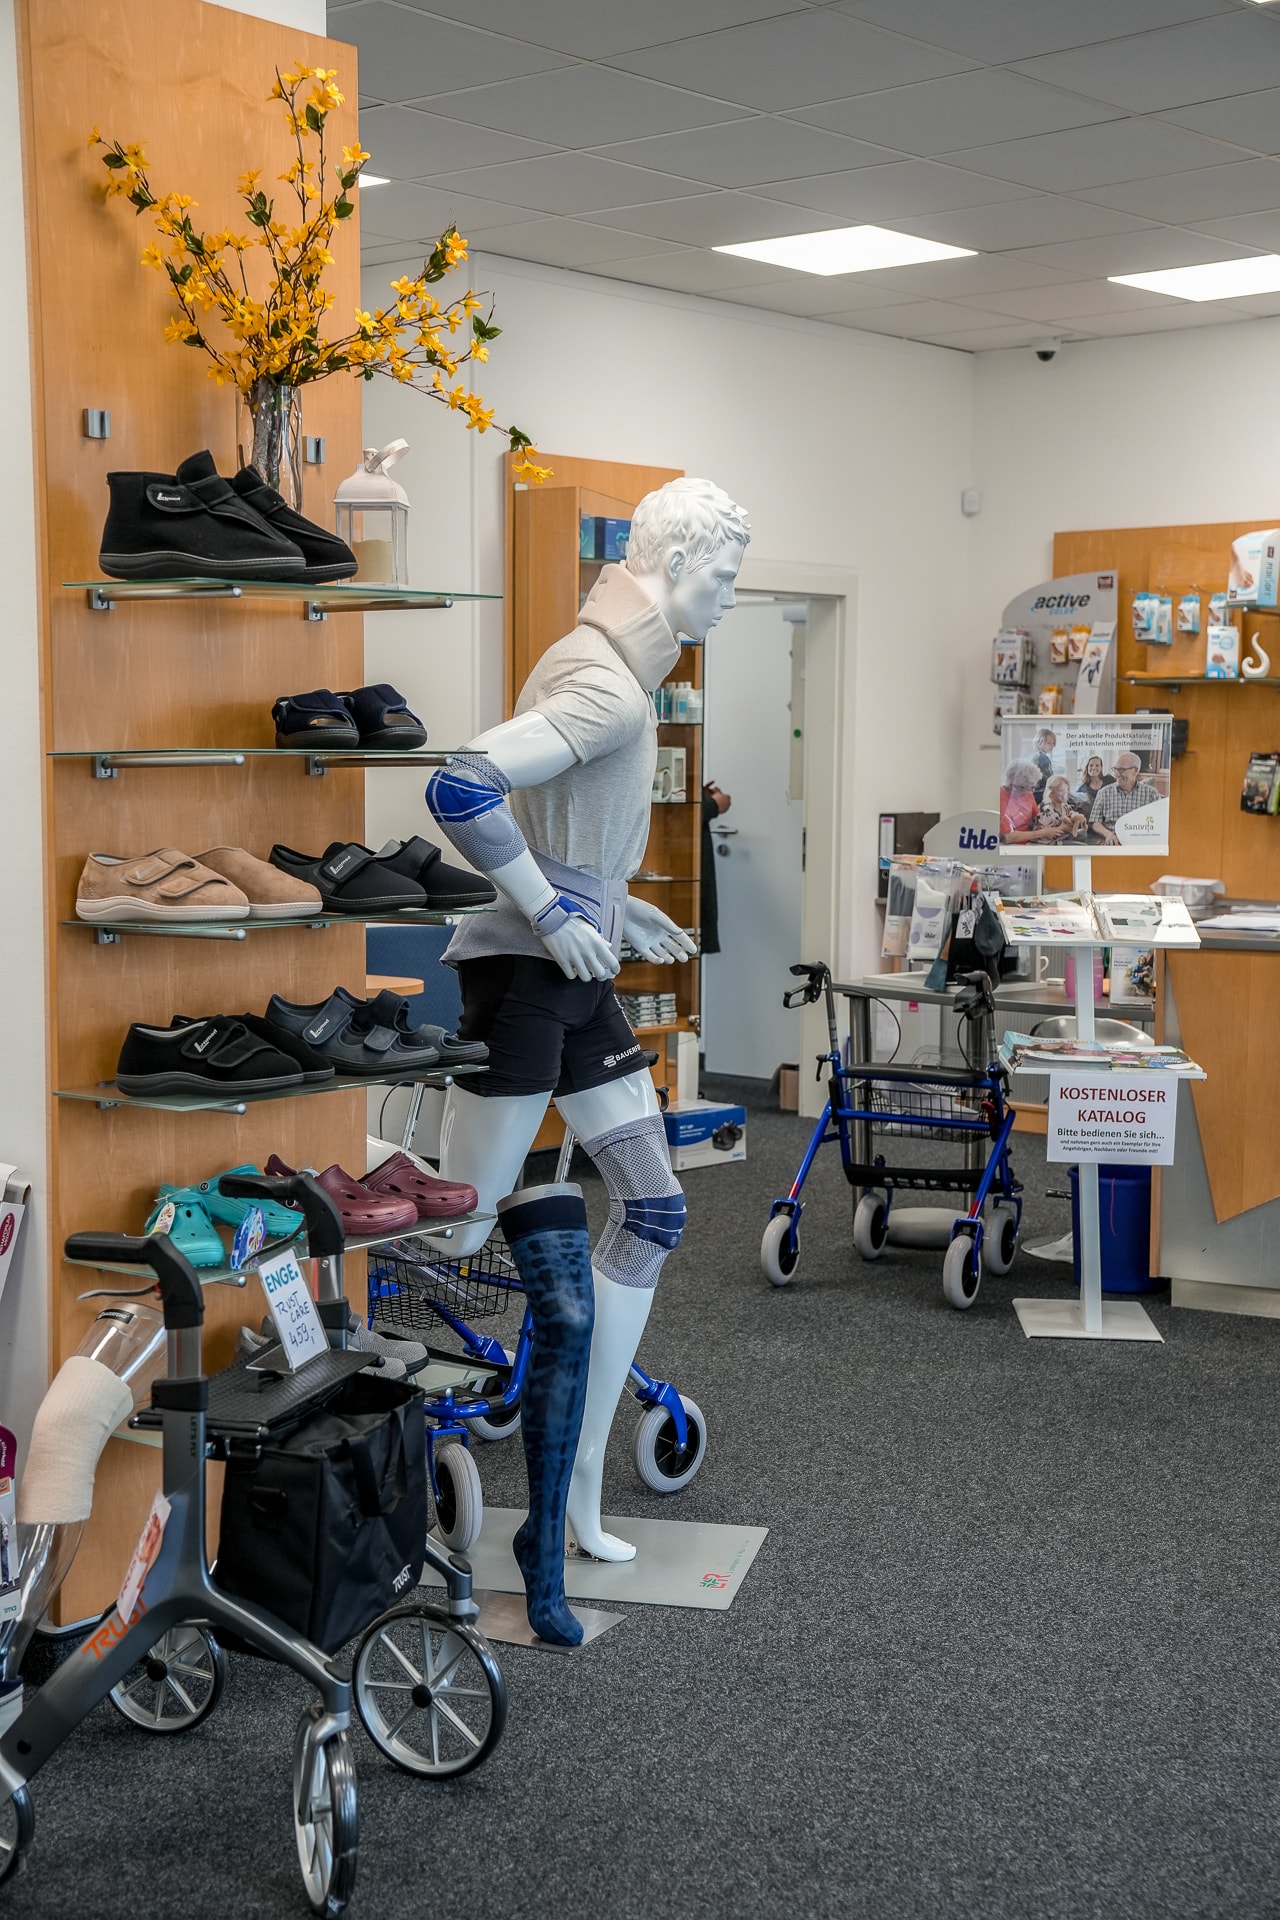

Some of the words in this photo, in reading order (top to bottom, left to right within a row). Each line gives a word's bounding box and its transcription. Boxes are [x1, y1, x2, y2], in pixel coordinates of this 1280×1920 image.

[1034, 592, 1091, 609] active
[1065, 732, 1078, 740] Der
[1078, 732, 1104, 740] aktuelle
[1104, 732, 1152, 741] Produktkatalog
[1069, 740, 1084, 748] jetzt
[959, 827, 998, 850] ihle
[1059, 1087, 1166, 1103] KOSTENLOSER
[1077, 1109, 1147, 1124] KATALOG
[1057, 1128, 1079, 1137] Bitte
[1080, 1128, 1122, 1138] bedienen
[1124, 1130, 1137, 1138] Sie
[1139, 1130, 1165, 1139] sich...
[264, 1263, 299, 1293] ENGE.
[275, 1291, 299, 1316] TRUST
[290, 1301, 311, 1323] CARE
[392, 1563, 412, 1593] TRUST
